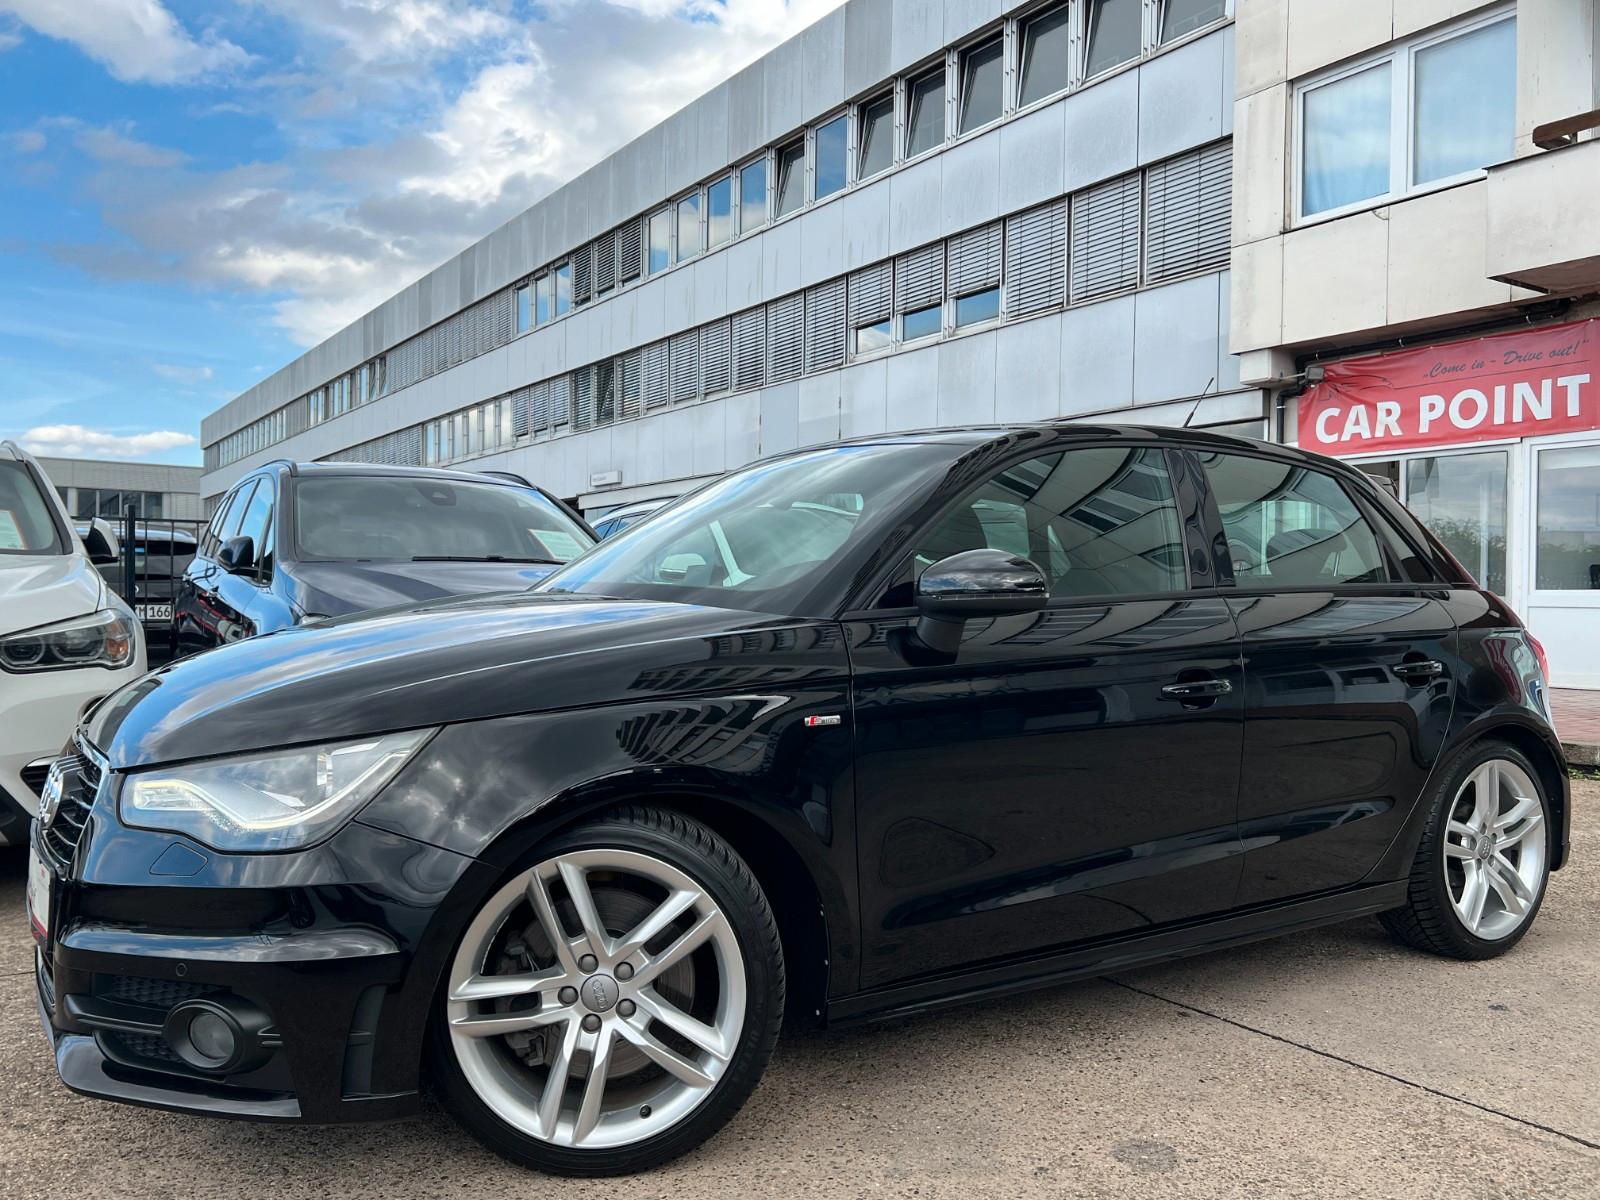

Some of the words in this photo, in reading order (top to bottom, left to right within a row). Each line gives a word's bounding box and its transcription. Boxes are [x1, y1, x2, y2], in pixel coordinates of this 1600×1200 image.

[1471, 359, 1485, 370] in
[1503, 350, 1545, 366] Drive
[1315, 401, 1403, 444] CAR
[1418, 373, 1591, 434] POINT
[149, 606, 171, 618] 166
